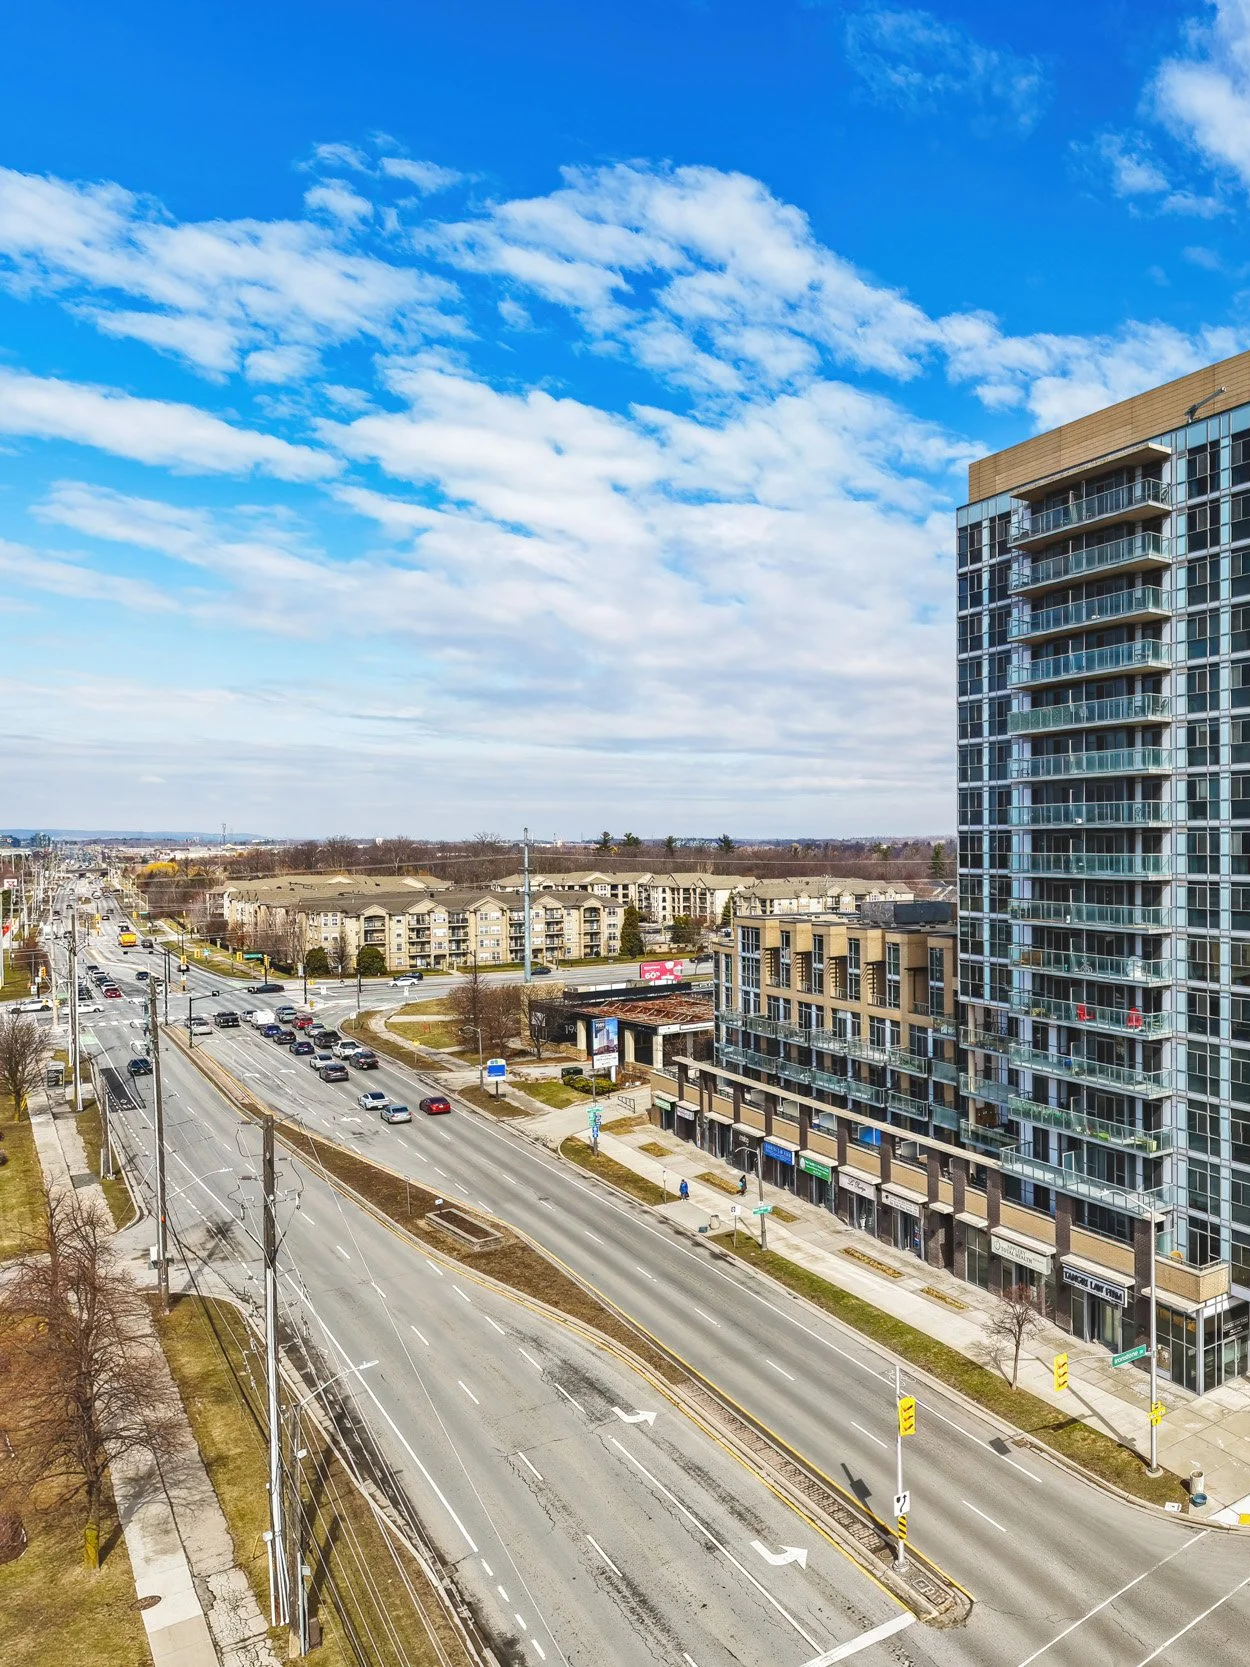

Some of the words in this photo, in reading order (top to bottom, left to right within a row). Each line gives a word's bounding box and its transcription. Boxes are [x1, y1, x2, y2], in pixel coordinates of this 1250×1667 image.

[1015, 1253, 1033, 1264] HEALTH
[1089, 1280, 1105, 1294] LAW
[1105, 1287, 1123, 1302] FIRM
